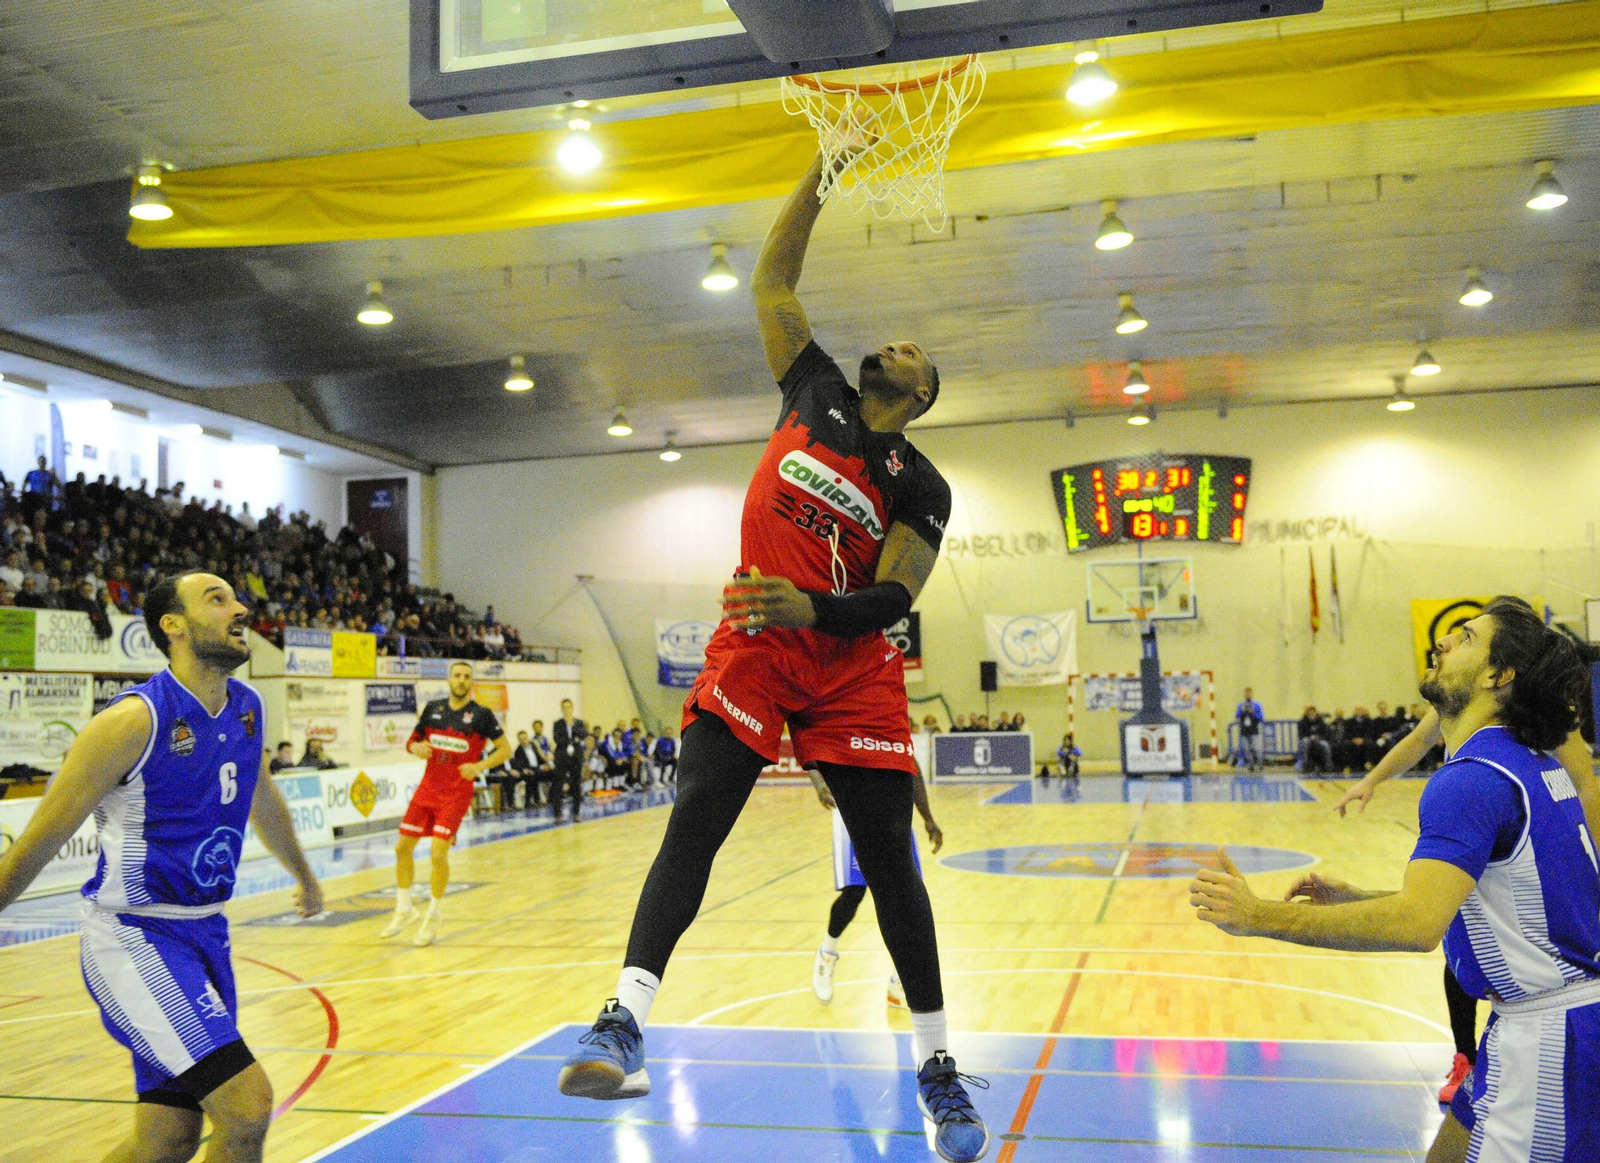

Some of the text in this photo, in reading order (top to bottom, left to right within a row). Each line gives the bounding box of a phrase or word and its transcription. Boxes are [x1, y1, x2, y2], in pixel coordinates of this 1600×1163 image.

[794, 502, 839, 540] 33
[722, 696, 764, 736] BERNER
[219, 762, 238, 805] 6
